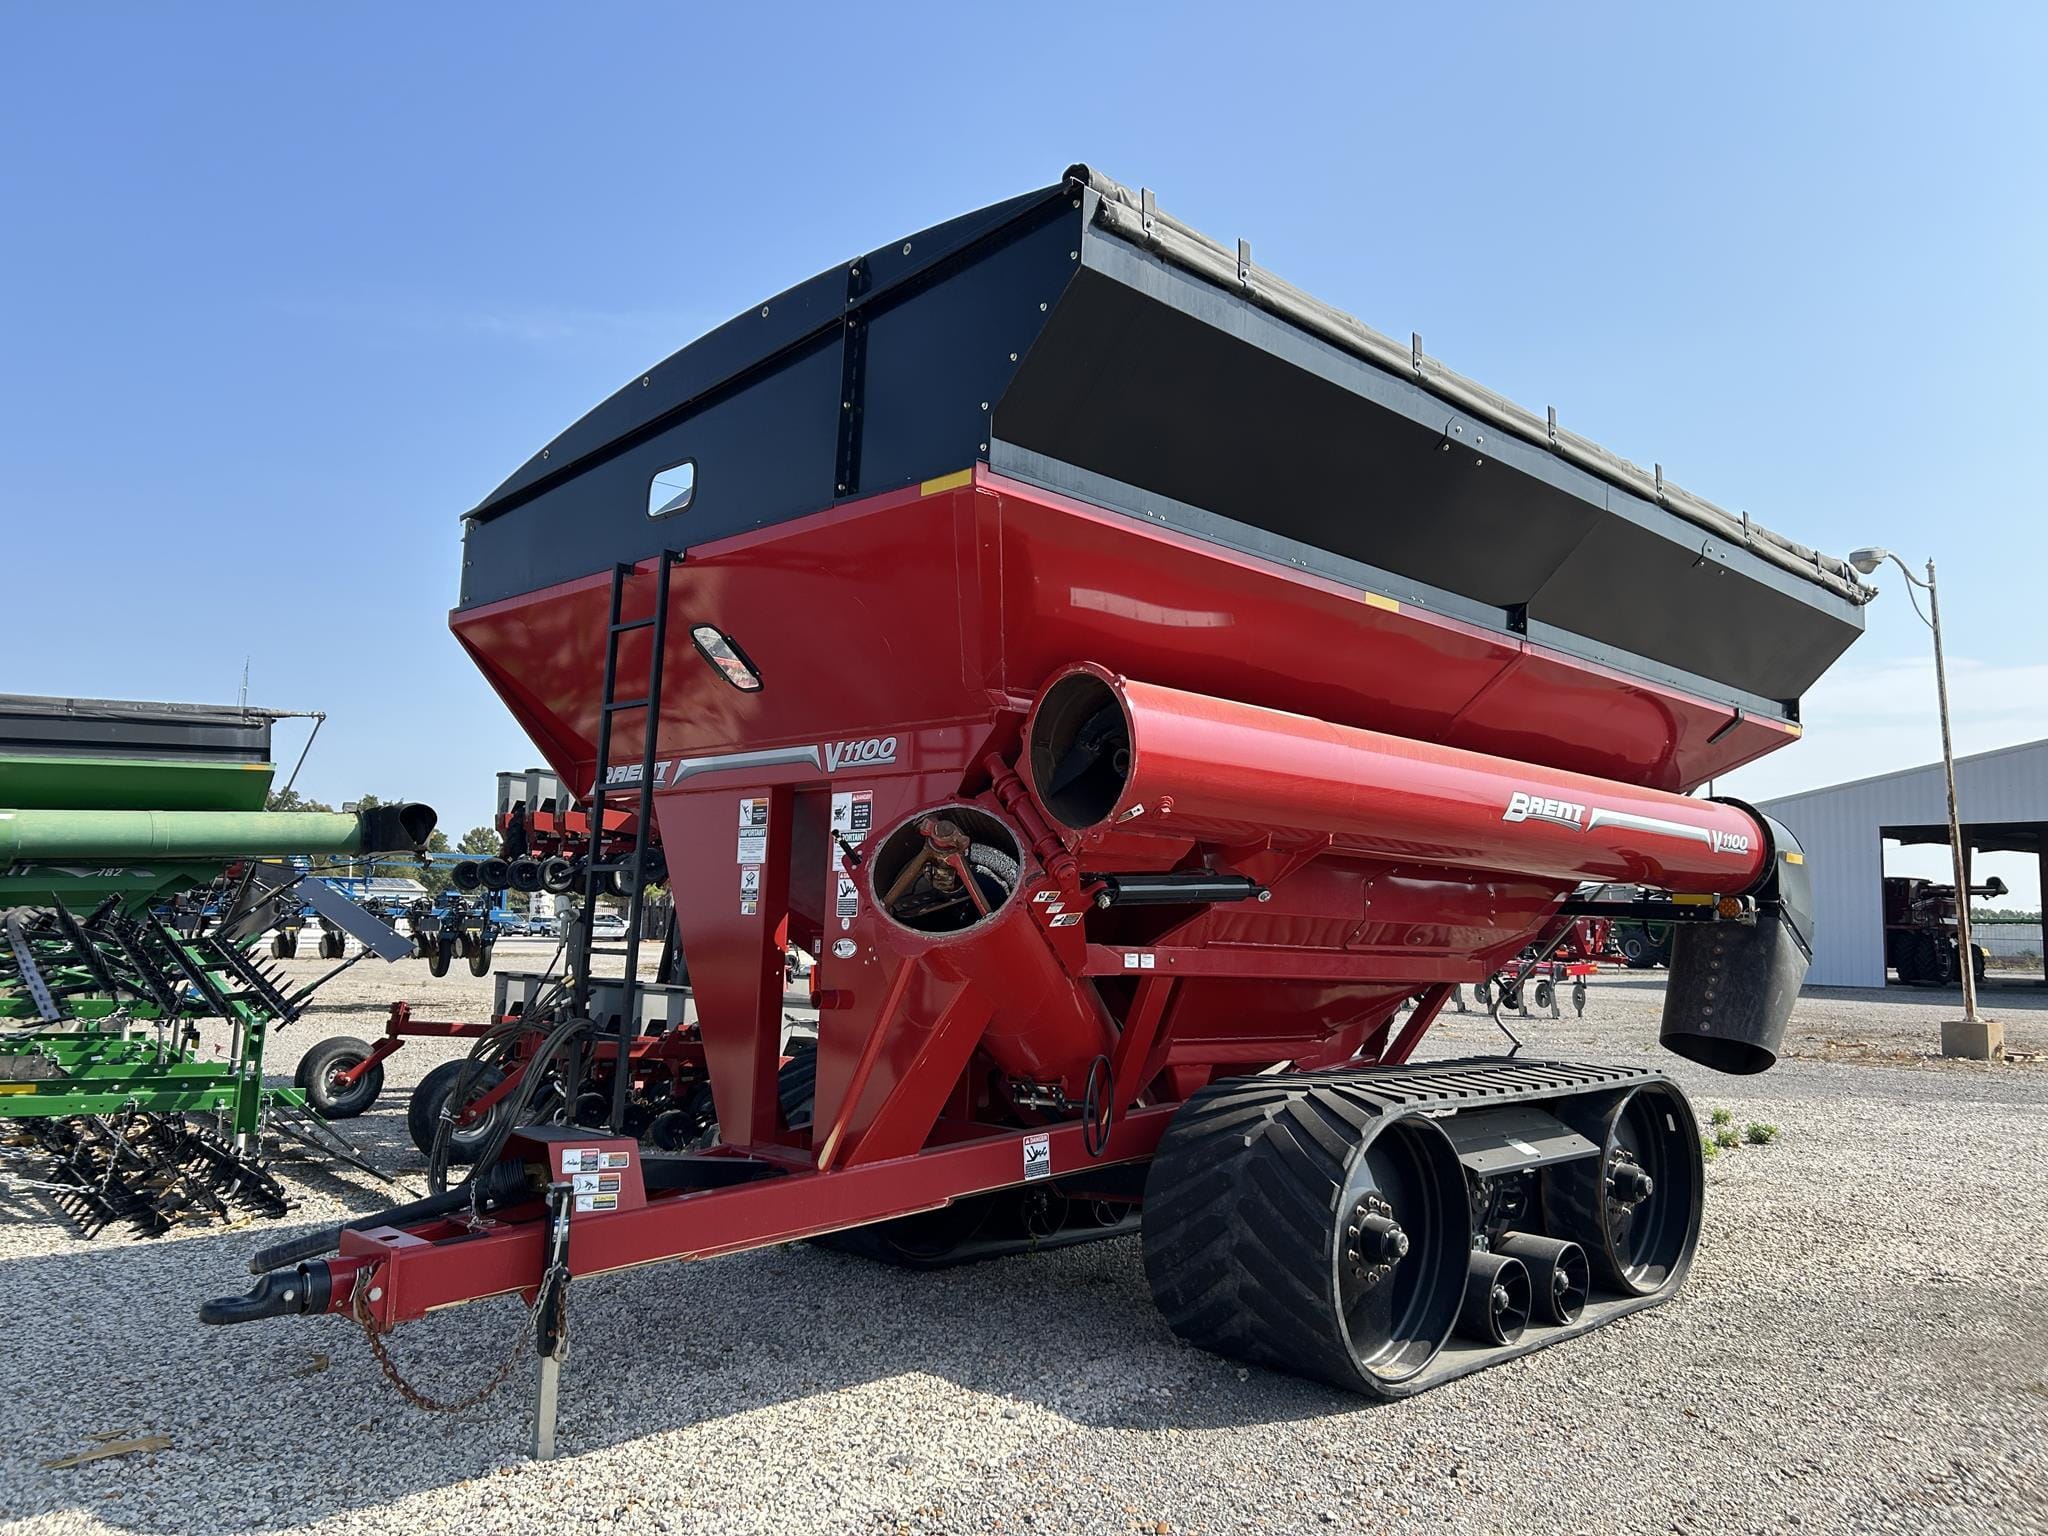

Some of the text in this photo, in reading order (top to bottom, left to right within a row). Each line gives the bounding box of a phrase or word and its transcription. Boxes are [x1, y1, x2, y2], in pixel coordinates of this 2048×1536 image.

[824, 737, 897, 774] V1100
[740, 829, 766, 837] IMPORTANT
[1502, 791, 1748, 854] BRENT V1100
[842, 832, 866, 842] PORTANT
